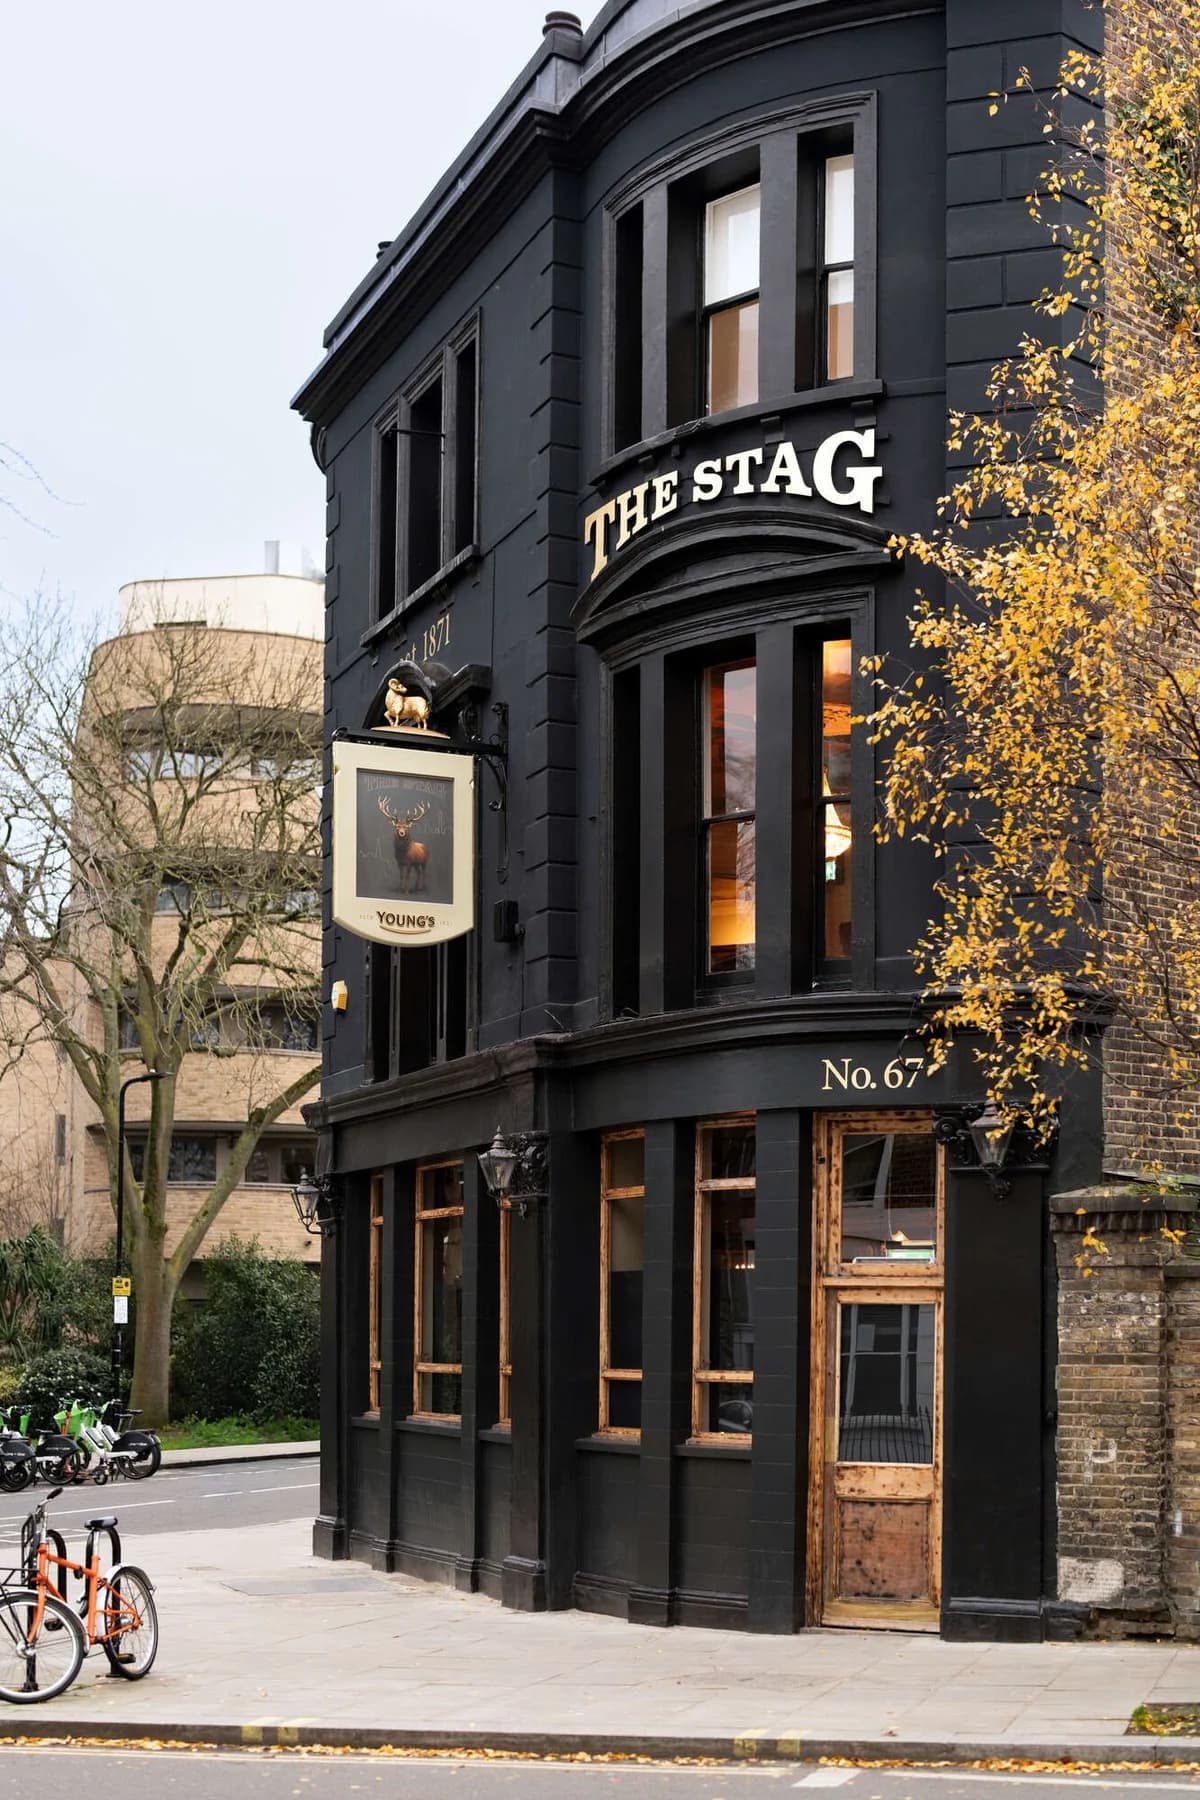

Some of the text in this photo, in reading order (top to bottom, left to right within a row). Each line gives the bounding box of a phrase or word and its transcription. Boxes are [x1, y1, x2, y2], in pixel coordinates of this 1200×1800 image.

[584, 428, 883, 582] THE STAG
[422, 612, 451, 662] 1871
[376, 911, 435, 928] YOUNG'S
[821, 1057, 924, 1090] No. 67
